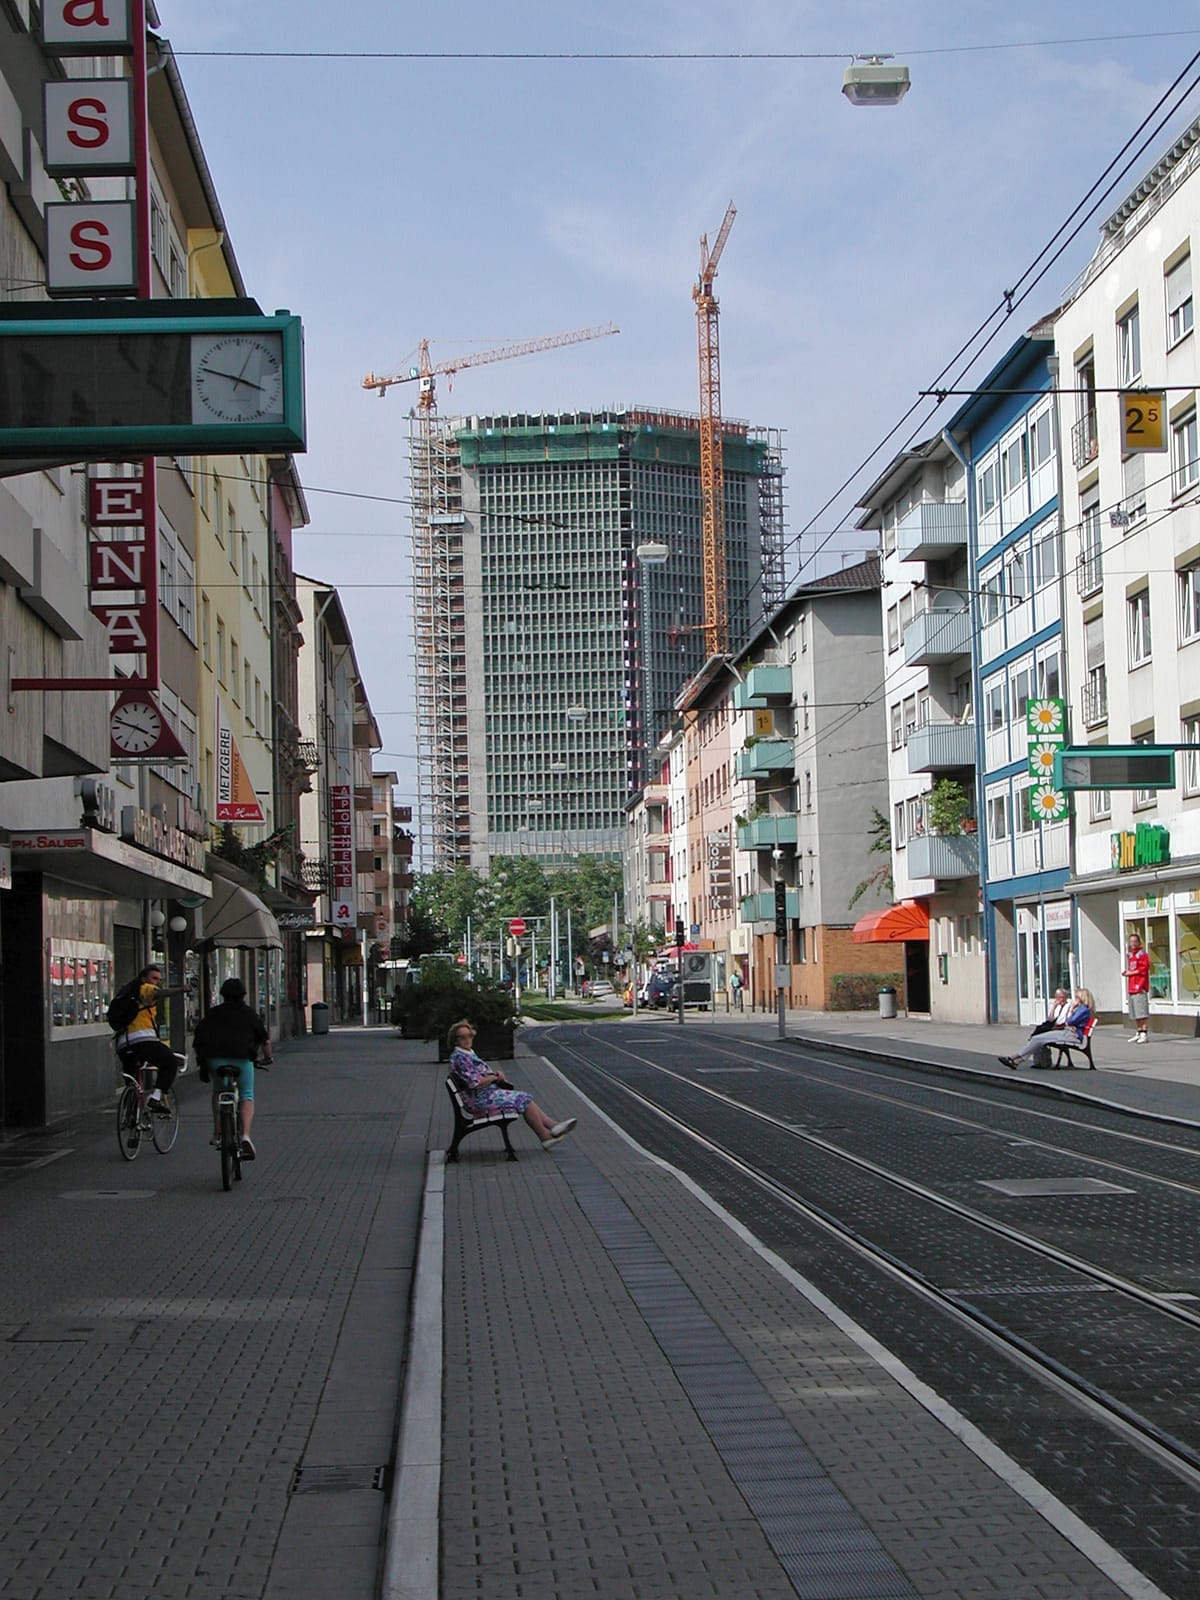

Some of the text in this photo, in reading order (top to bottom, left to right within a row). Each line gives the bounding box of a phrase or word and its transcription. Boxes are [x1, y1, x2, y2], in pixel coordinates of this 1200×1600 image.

[219, 727, 231, 801] METZGEREI
[340, 786, 352, 886] APOTHEKE
[711, 847, 721, 910] OPTIK
